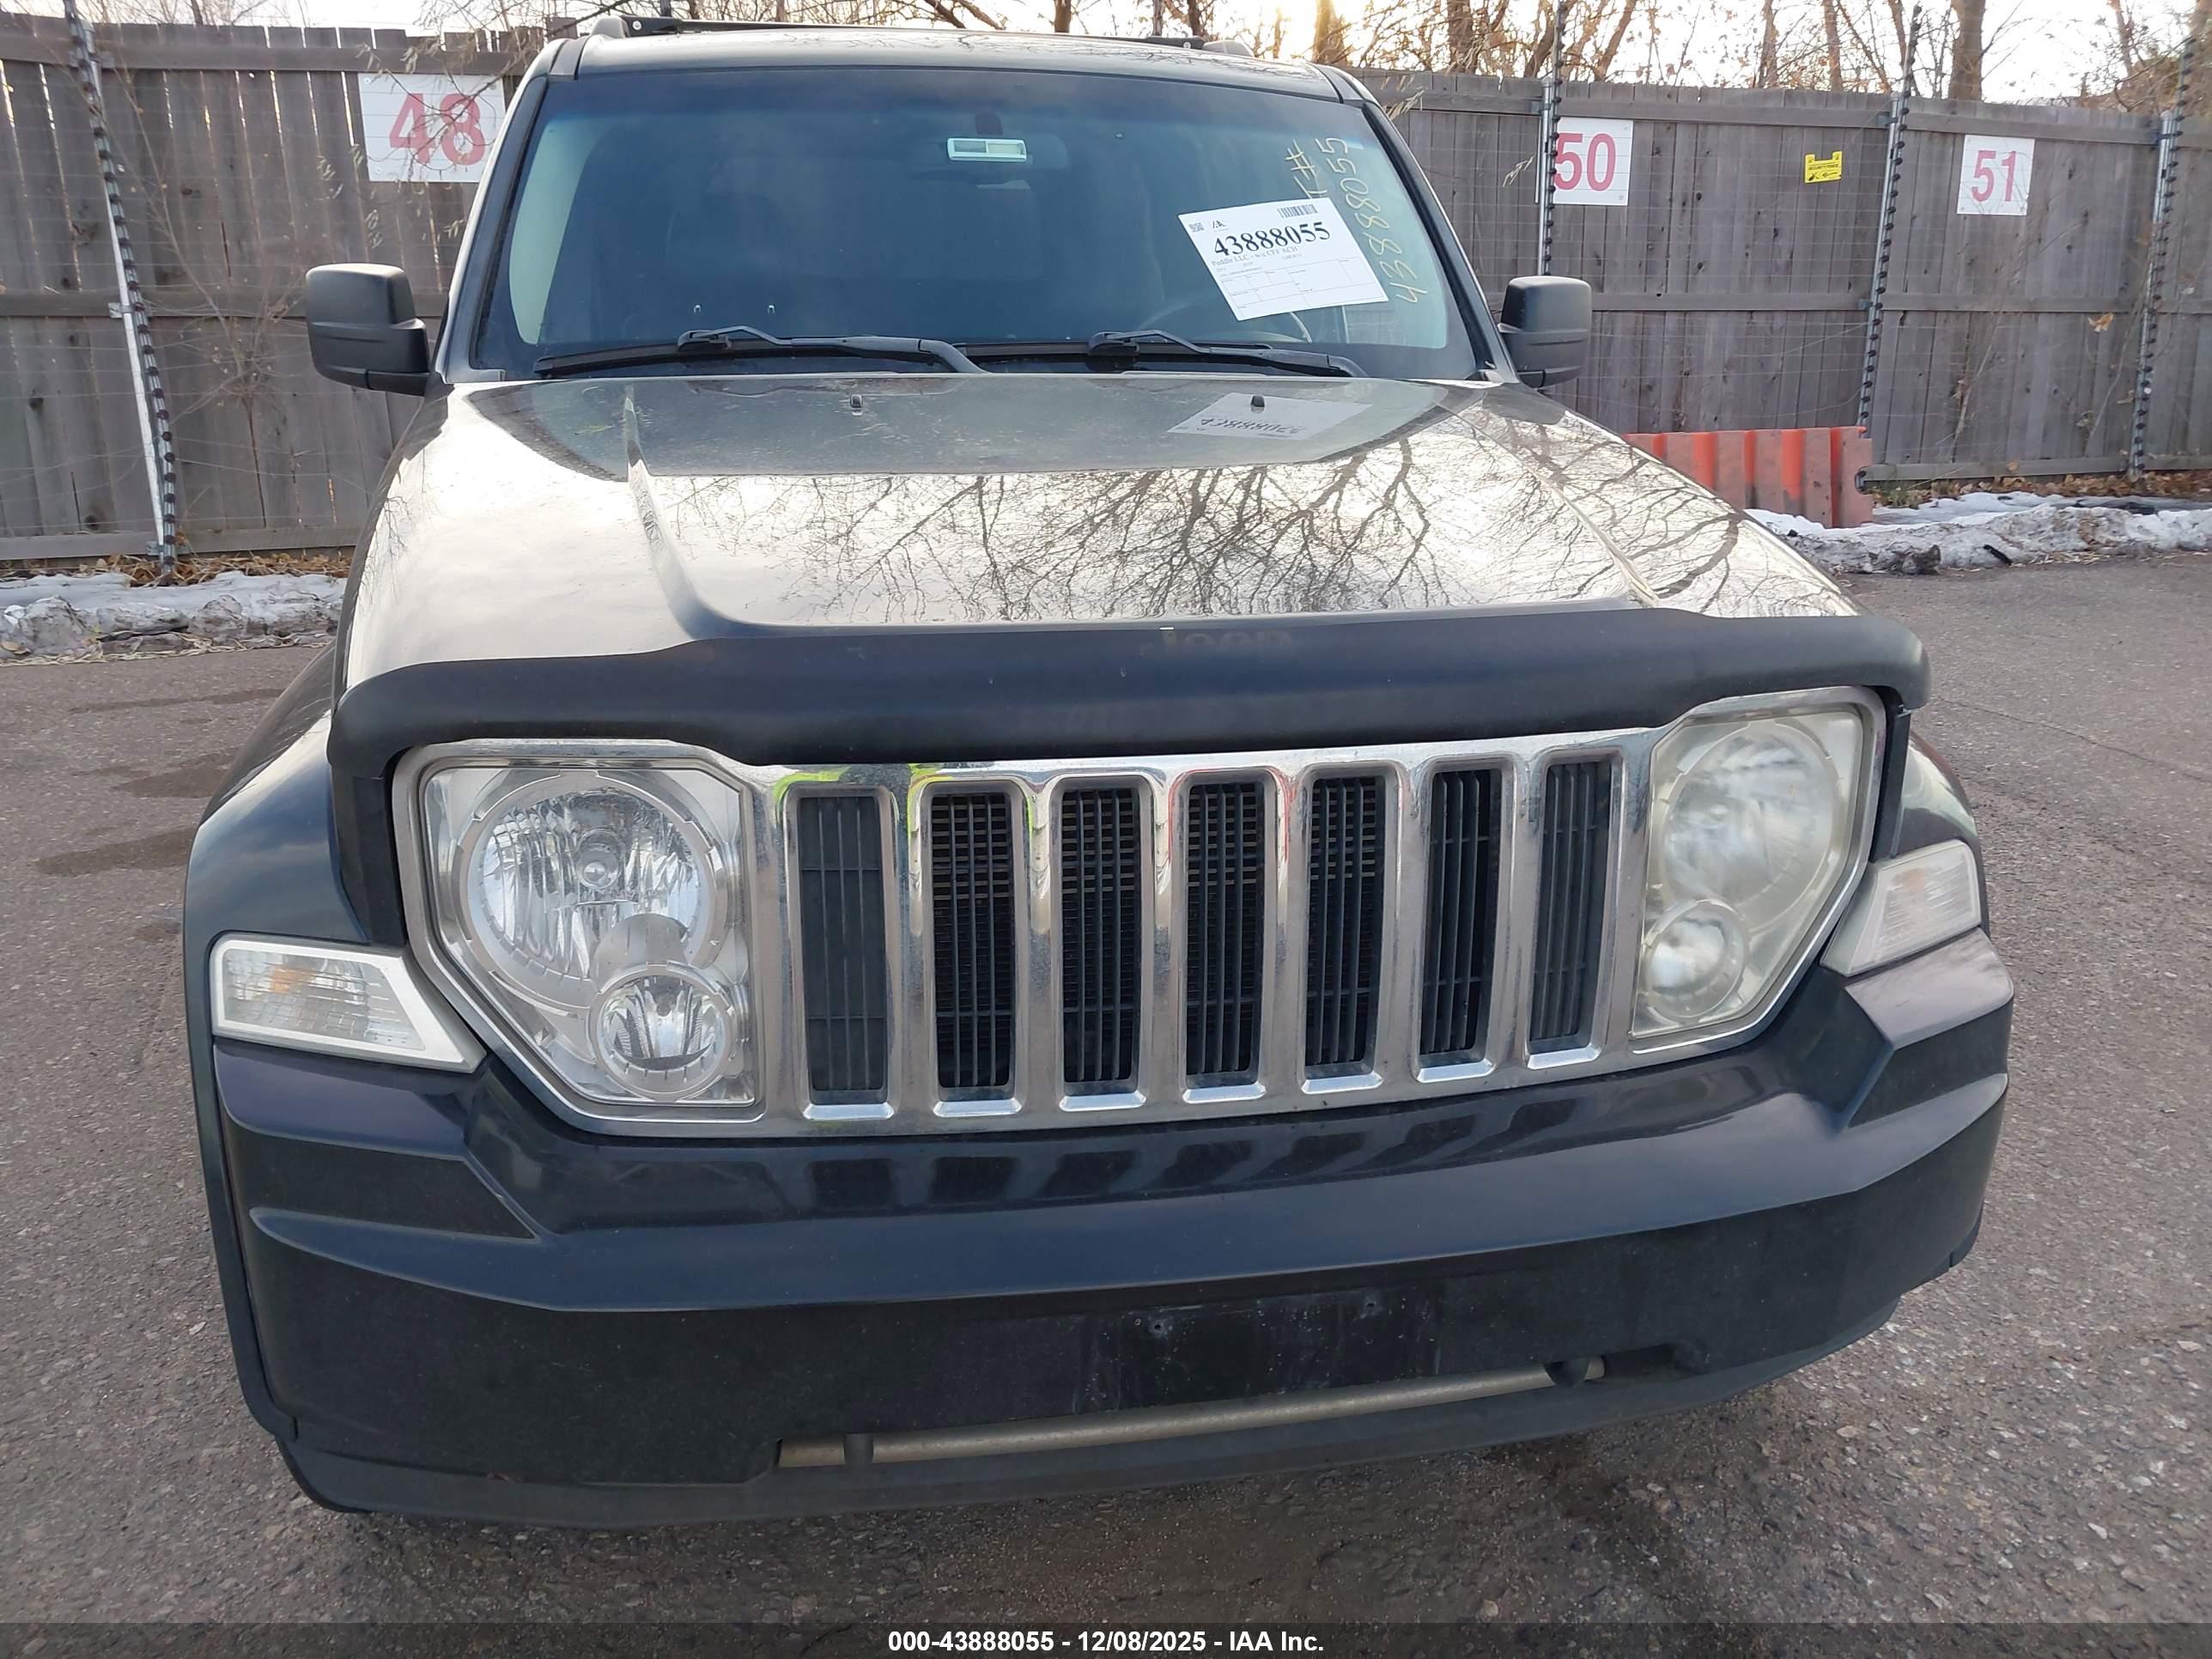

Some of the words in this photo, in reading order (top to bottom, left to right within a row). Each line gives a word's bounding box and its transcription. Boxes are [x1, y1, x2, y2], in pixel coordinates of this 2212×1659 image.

[389, 93, 485, 166] 48
[1553, 132, 1616, 191] 50
[1972, 150, 2017, 202] 51
[1214, 222, 1331, 256] 43888055
[1315, 137, 1429, 303] 43888055
